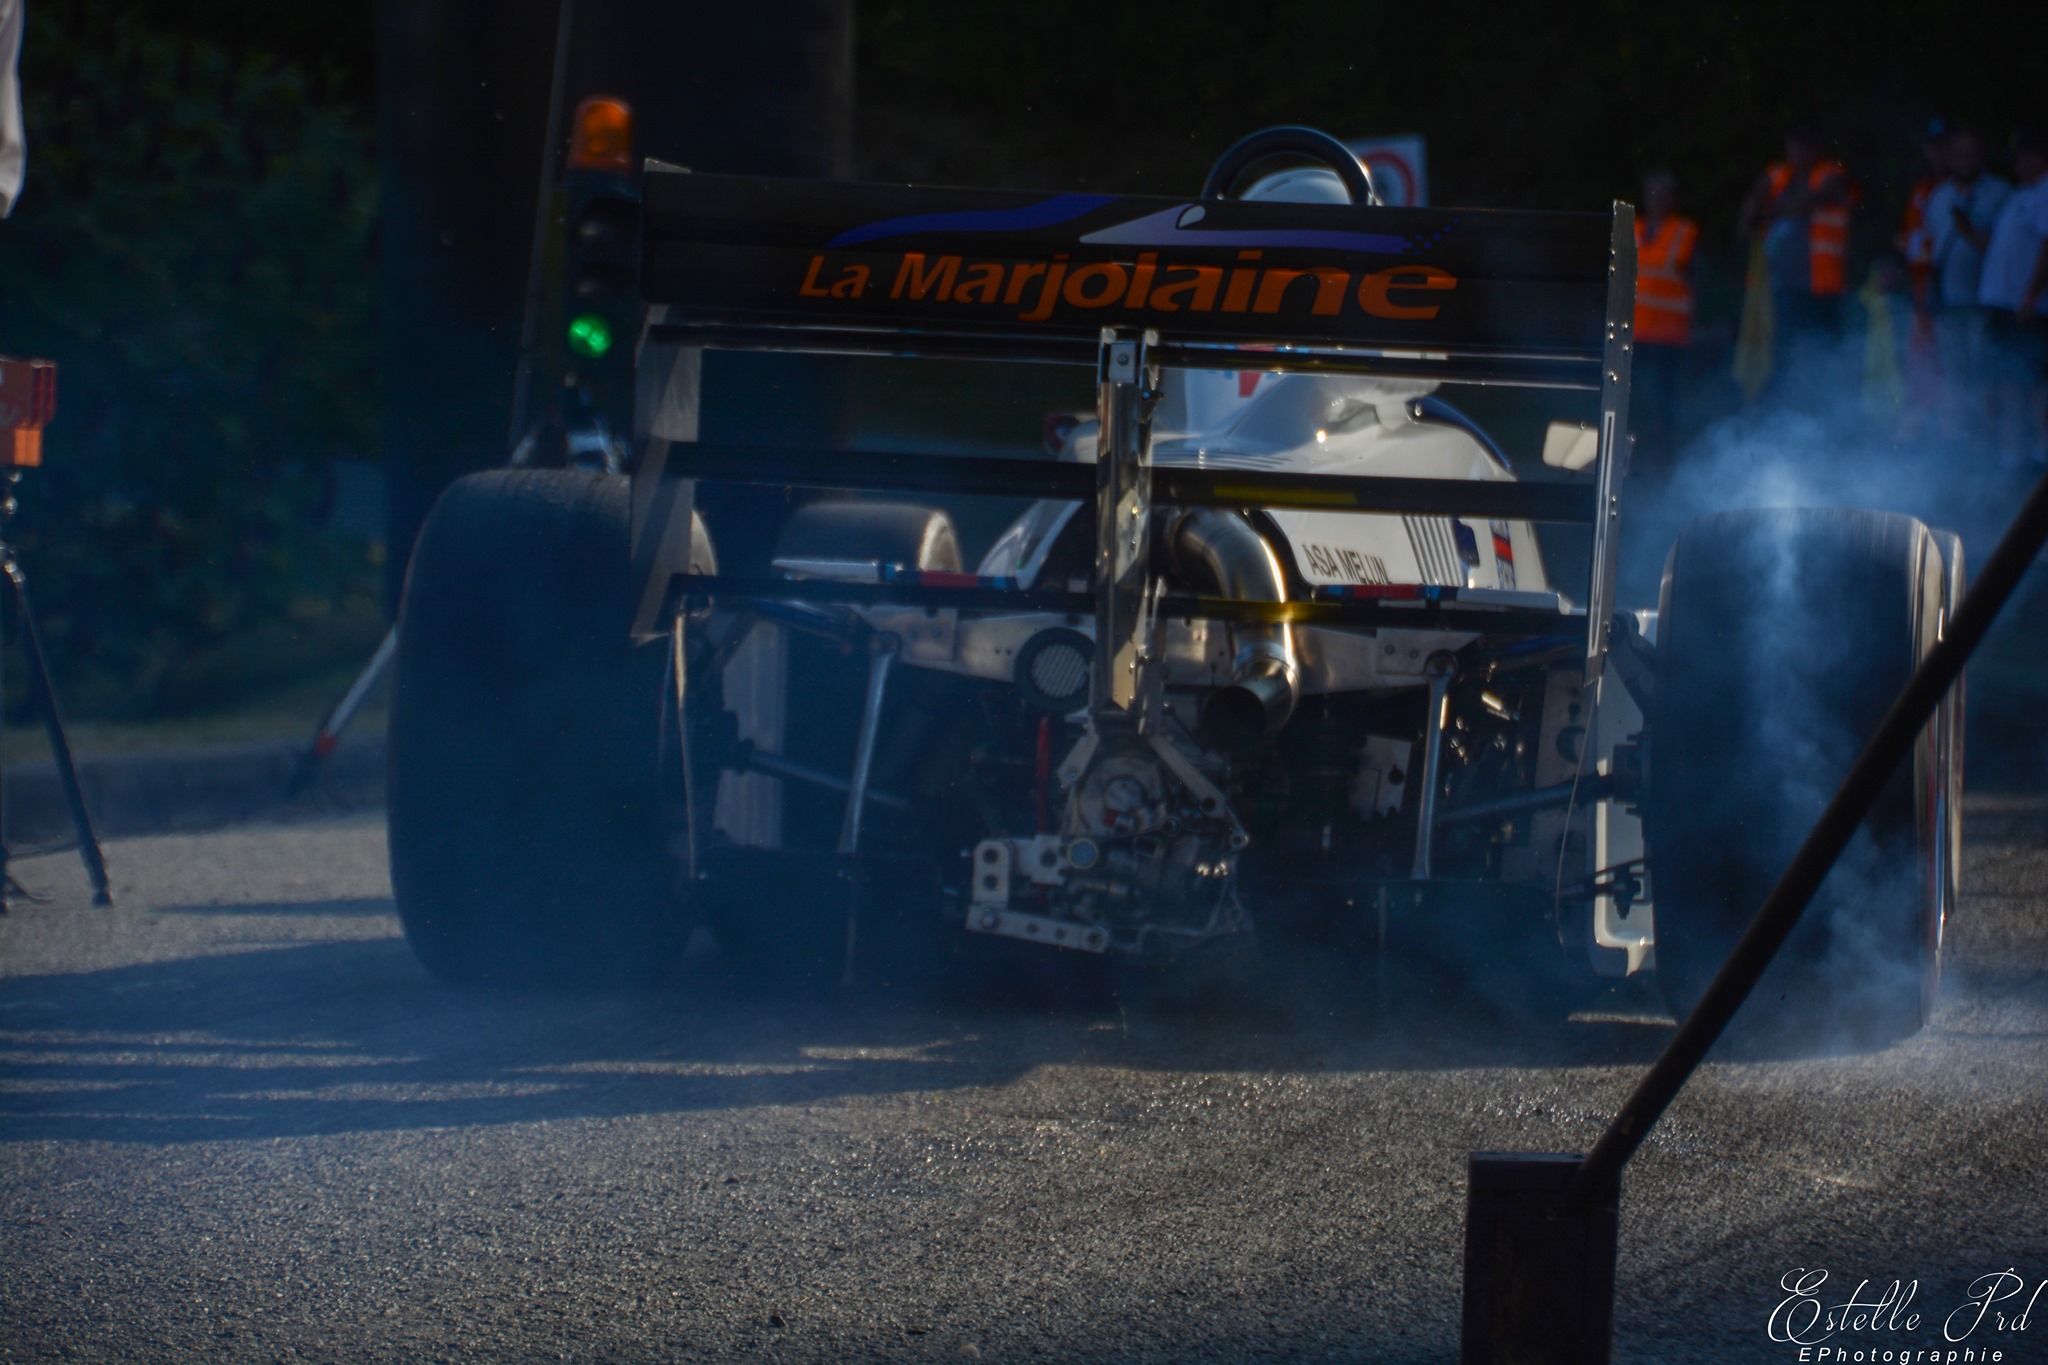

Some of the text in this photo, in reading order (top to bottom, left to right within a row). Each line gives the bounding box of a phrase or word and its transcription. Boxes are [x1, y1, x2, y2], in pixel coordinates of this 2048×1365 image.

[800, 249, 1458, 322] La Marjolaine
[1301, 543, 1390, 585] ASA MELUN
